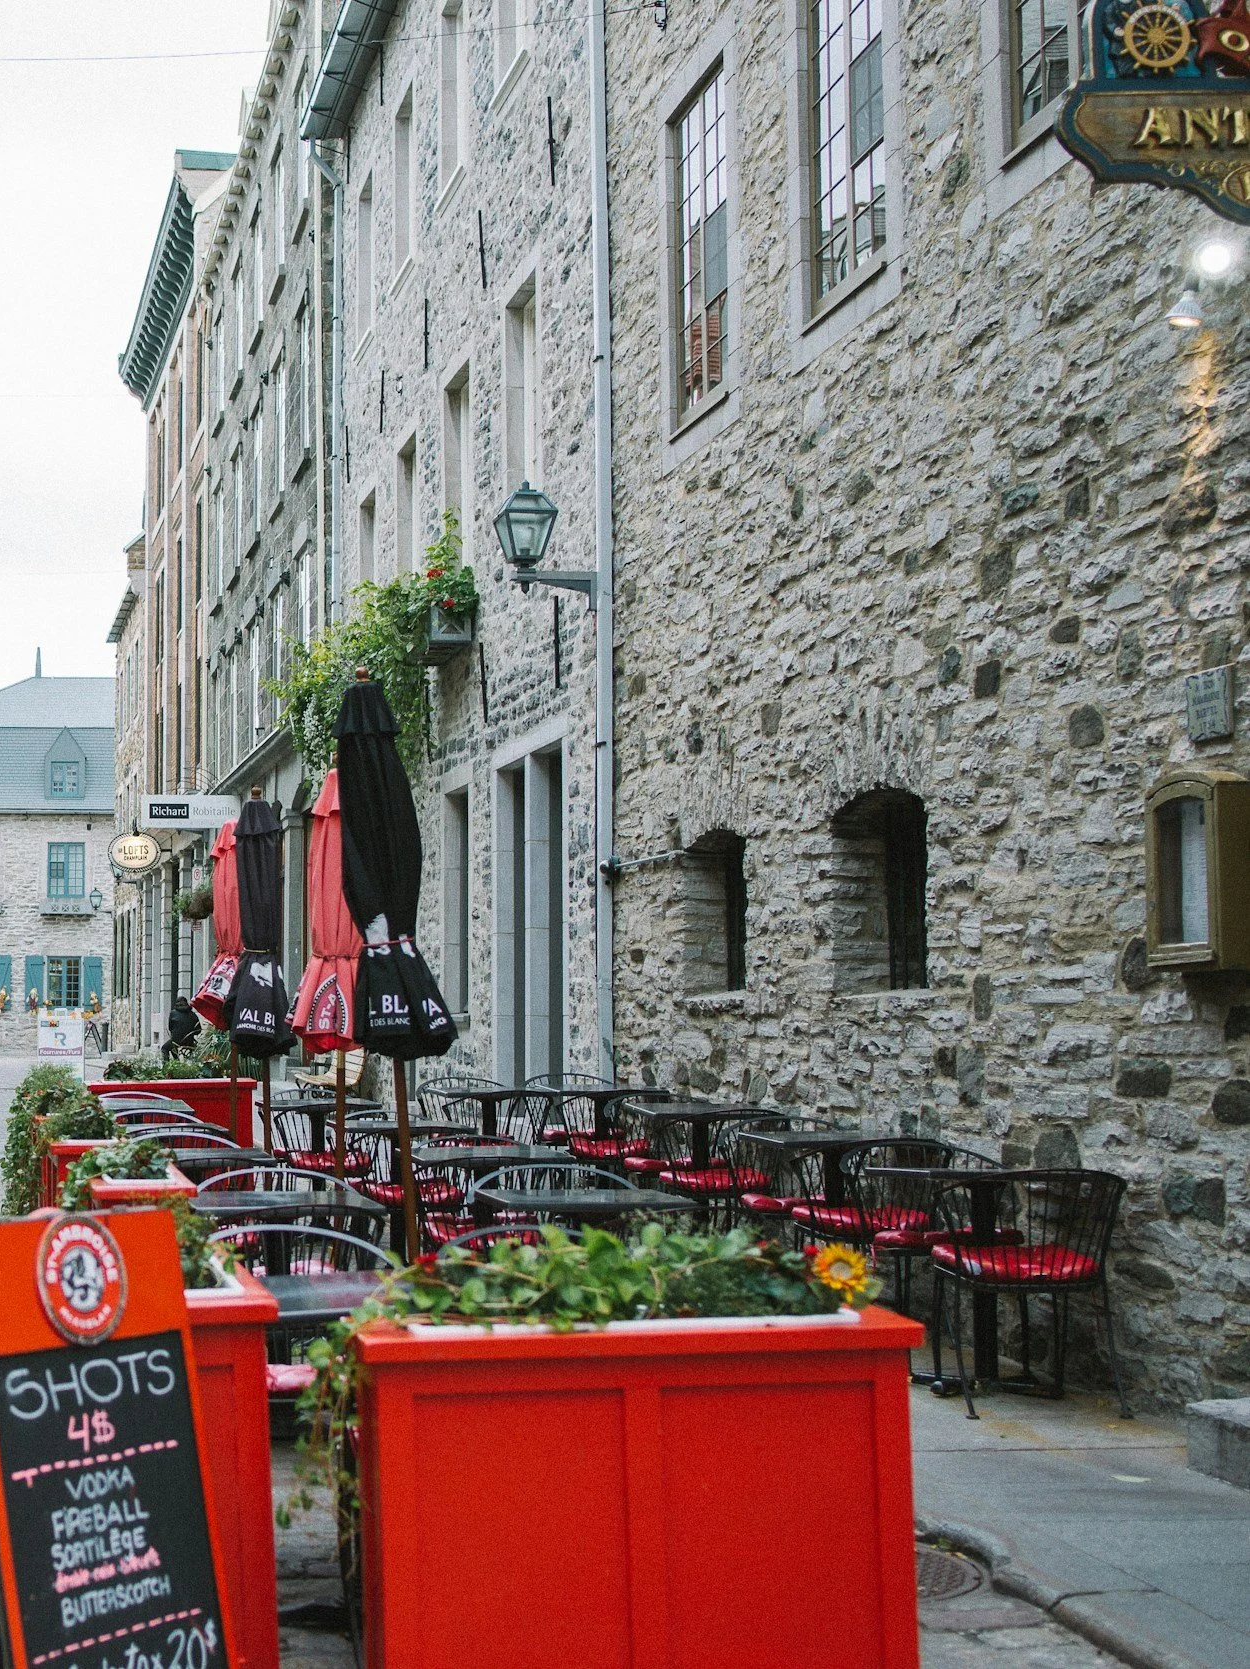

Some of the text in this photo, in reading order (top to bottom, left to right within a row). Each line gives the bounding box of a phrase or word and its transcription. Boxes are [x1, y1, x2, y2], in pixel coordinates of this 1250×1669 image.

[151, 806, 236, 817] Richard Robitaille
[123, 845, 149, 855] LOFTS
[374, 1018, 386, 1027] DES
[5, 1349, 175, 1420] SHOTS
[67, 1408, 116, 1453] 4$
[64, 1465, 136, 1500] VODKA
[60, 1574, 171, 1628] BUTTERSCOTCH
